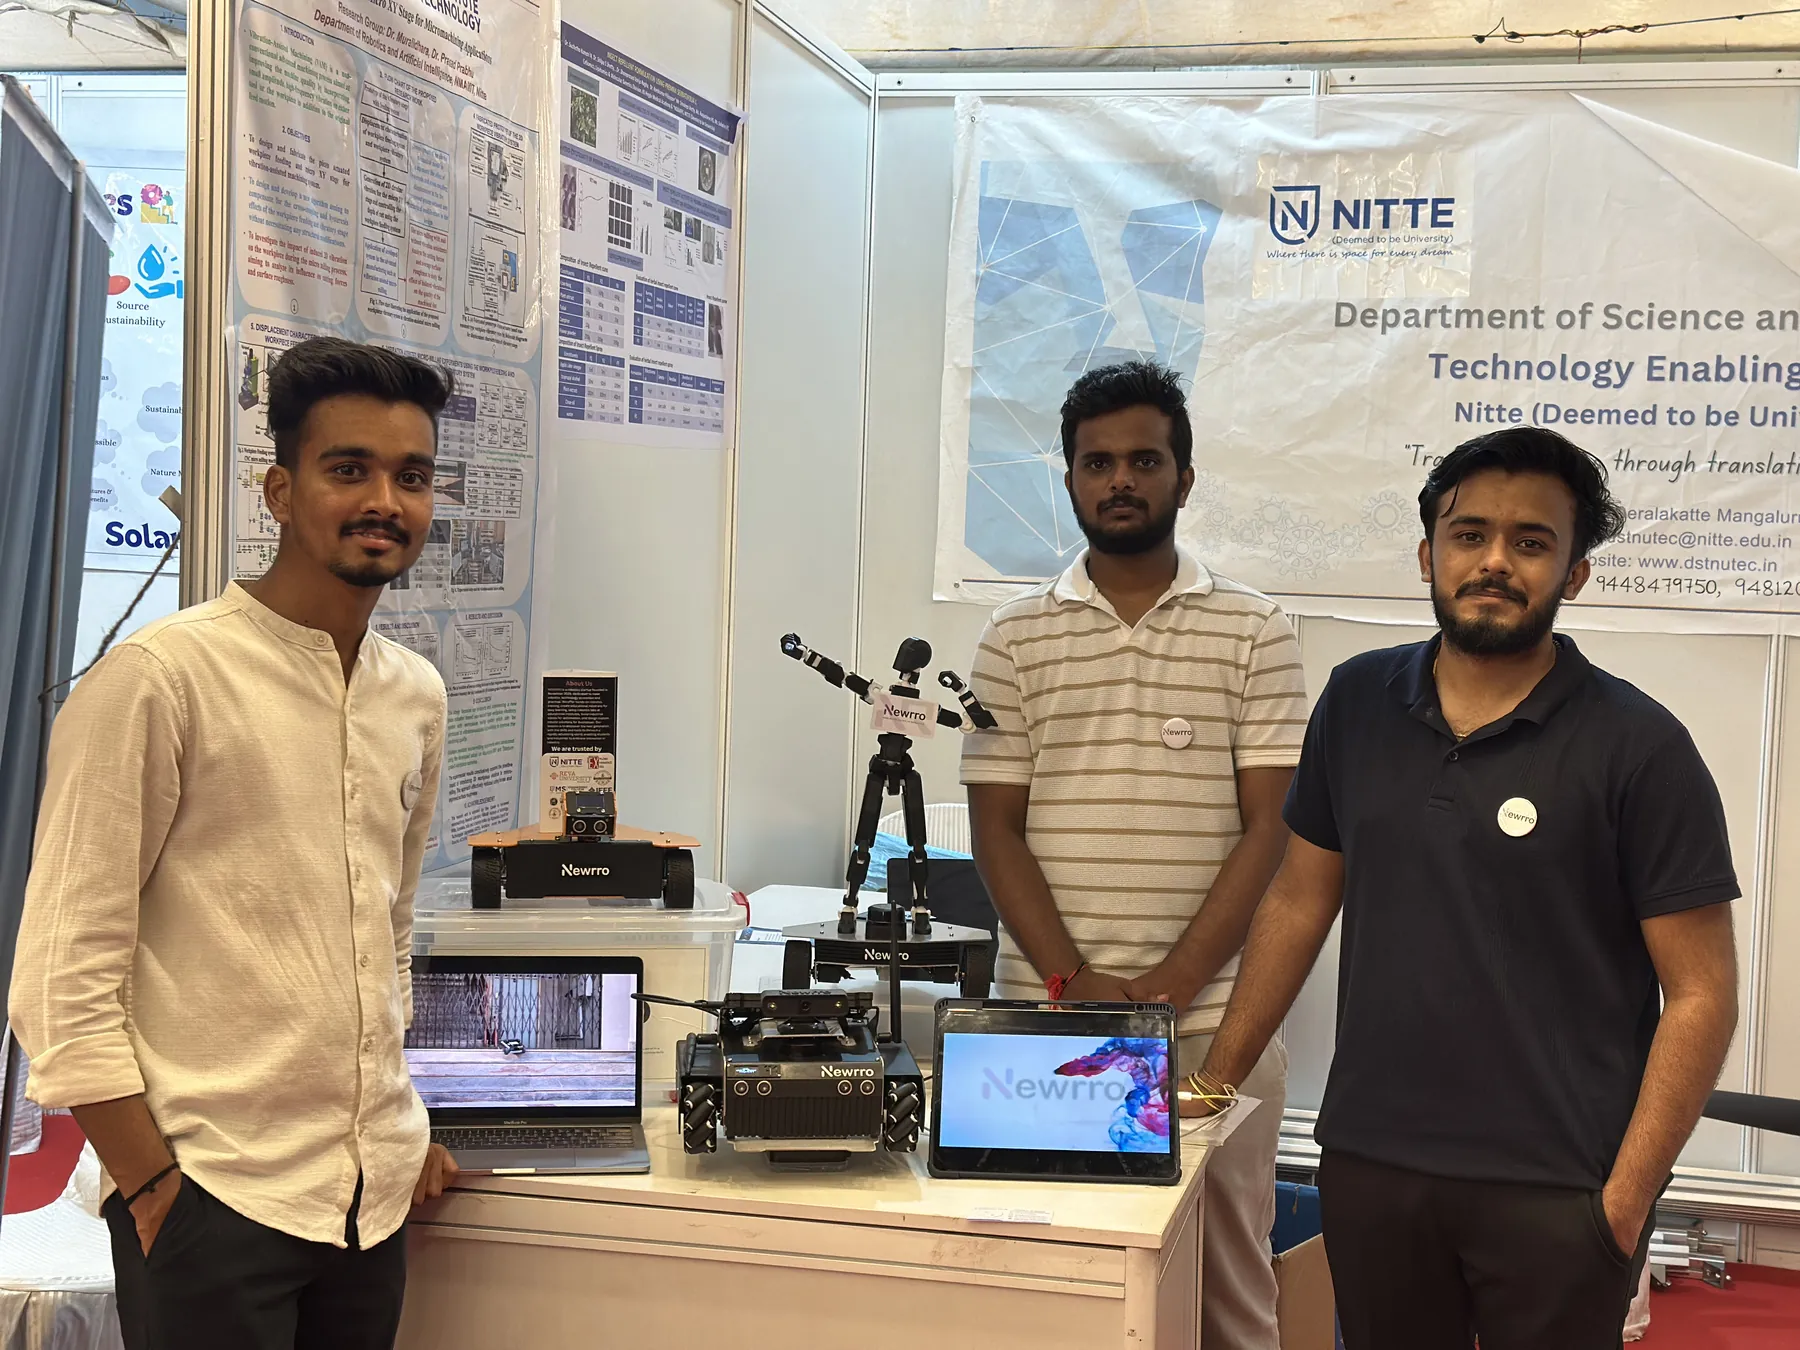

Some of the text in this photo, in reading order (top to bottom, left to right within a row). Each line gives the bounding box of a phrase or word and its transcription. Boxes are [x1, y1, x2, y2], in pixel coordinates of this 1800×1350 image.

[313, 8, 355, 34] Department
[356, 26, 362, 39] of
[362, 31, 386, 50] Robotics
[387, 44, 398, 58] and
[338, 2, 363, 24] Research
[364, 16, 385, 35] Group:
[386, 27, 395, 40] Dr.
[431, 48, 440, 62] Dr.
[398, 6, 414, 25] Stage
[415, 14, 424, 27] for
[424, 18, 464, 52] Micromachining
[1333, 198, 1455, 230] NITTE
[1332, 236, 1374, 244] (Deemed
[1389, 235, 1400, 243] be
[1403, 234, 1453, 244] University)
[1267, 250, 1297, 258] Where
[1300, 250, 1325, 258] there
[1329, 250, 1337, 258] is
[1341, 250, 1368, 259] space
[1371, 249, 1386, 259] for
[1390, 250, 1417, 258] every
[116, 301, 150, 310] Source
[104, 316, 166, 328] ustainability
[1334, 302, 1545, 335] Department
[1556, 302, 1594, 330] of
[1602, 302, 1744, 330] Science
[1429, 353, 1634, 388] Technology
[1455, 402, 1800, 427] Nitte (Deemed to be Uni
[150, 469, 176, 477] Nature
[1614, 448, 1695, 483] through
[1626, 507, 1800, 526] eralakatte Mangalur
[1638, 556, 1777, 572] www.dstnutec.in
[1596, 576, 1721, 598] 9448479750,
[884, 704, 926, 720] Newrro
[561, 864, 610, 876] Newrro
[821, 1065, 874, 1077] Newrro
[982, 1067, 1125, 1101] Newrro
